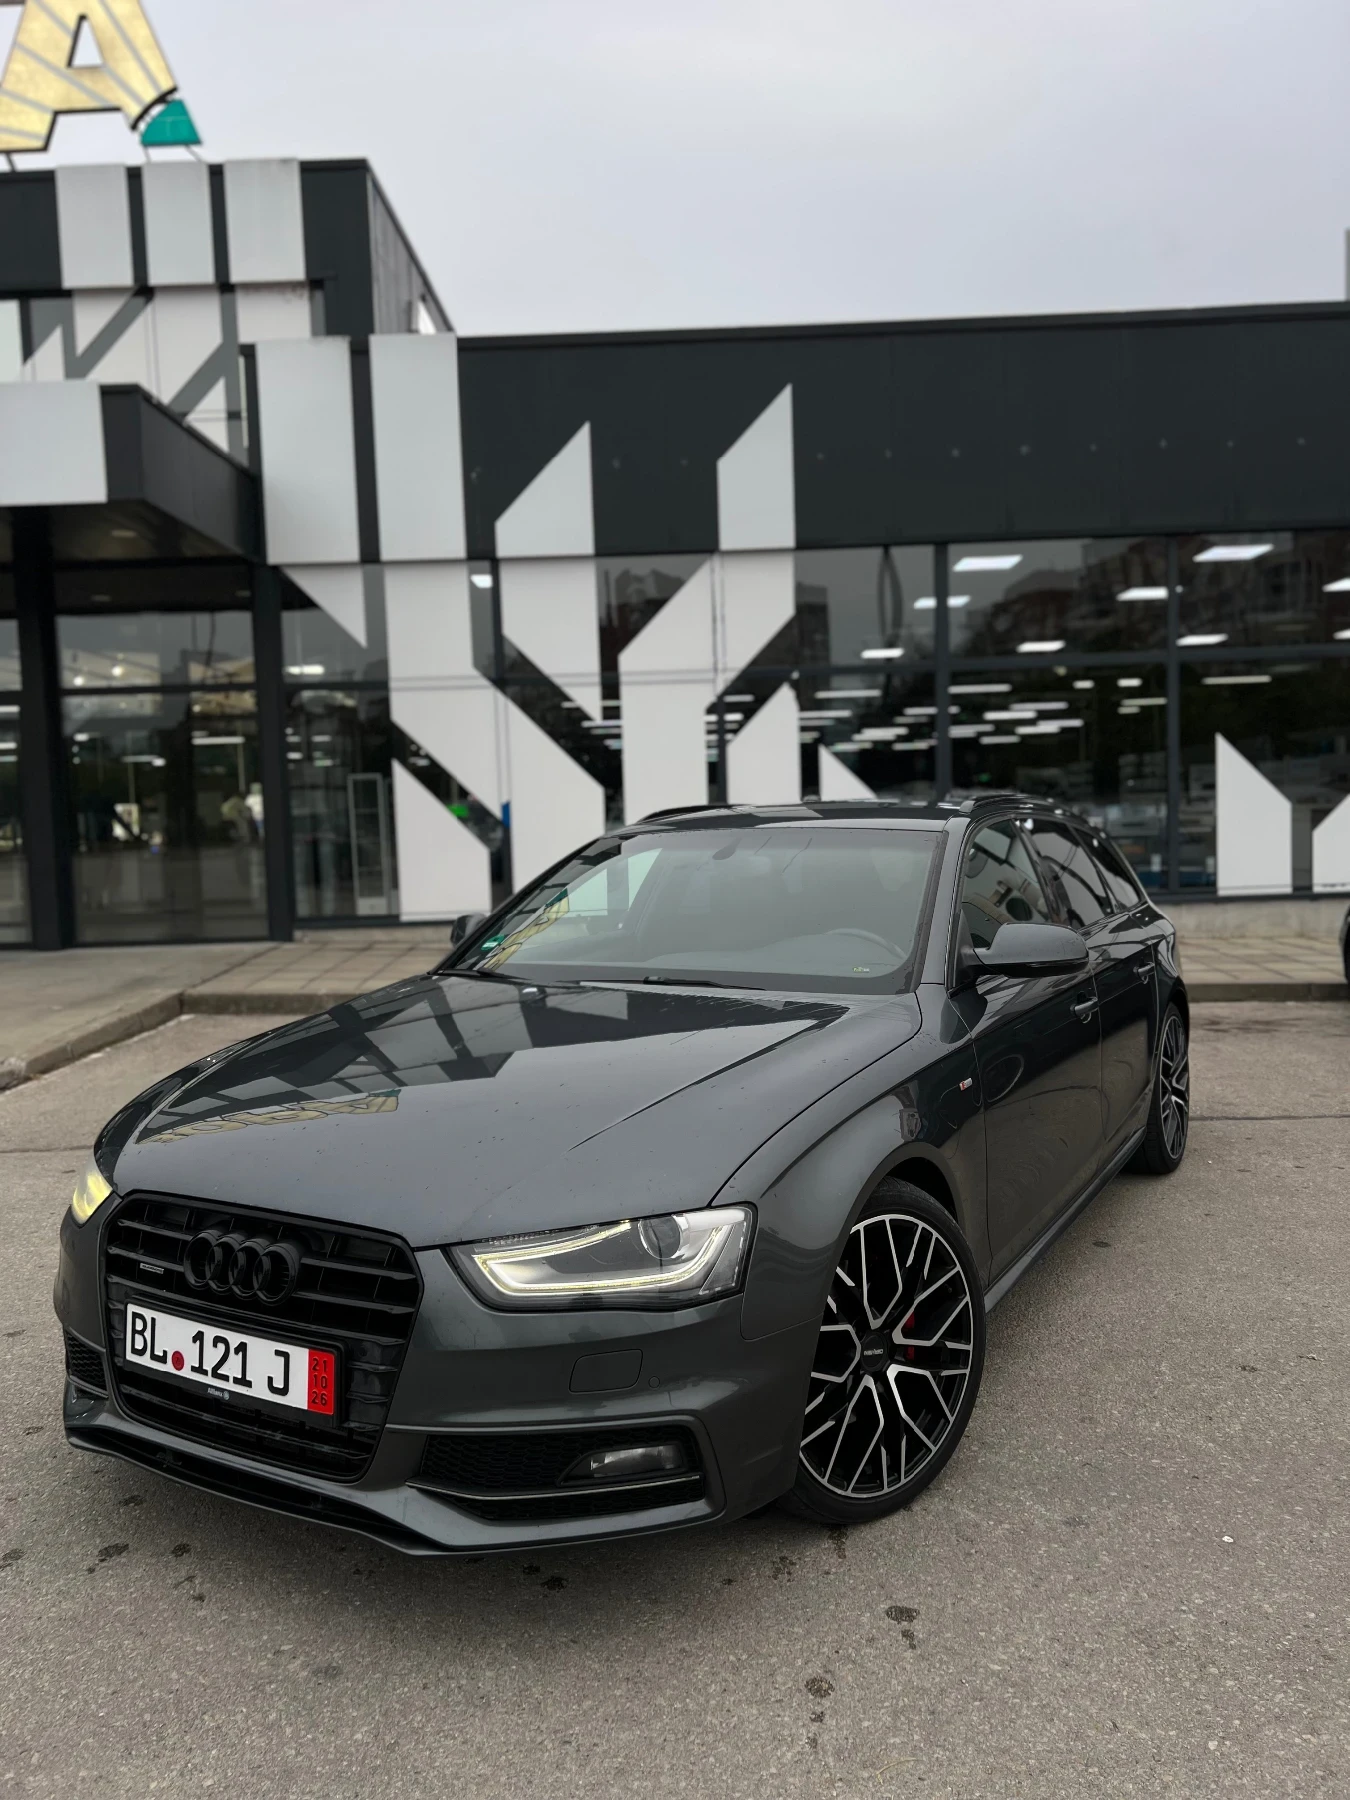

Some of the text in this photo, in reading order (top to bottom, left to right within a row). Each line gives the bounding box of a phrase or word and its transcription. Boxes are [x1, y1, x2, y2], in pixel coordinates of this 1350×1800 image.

[130, 1310, 290, 1397] BL 121 J
[311, 1356, 328, 1373] 21
[313, 1372, 328, 1389] 10
[311, 1389, 328, 1406] 26
